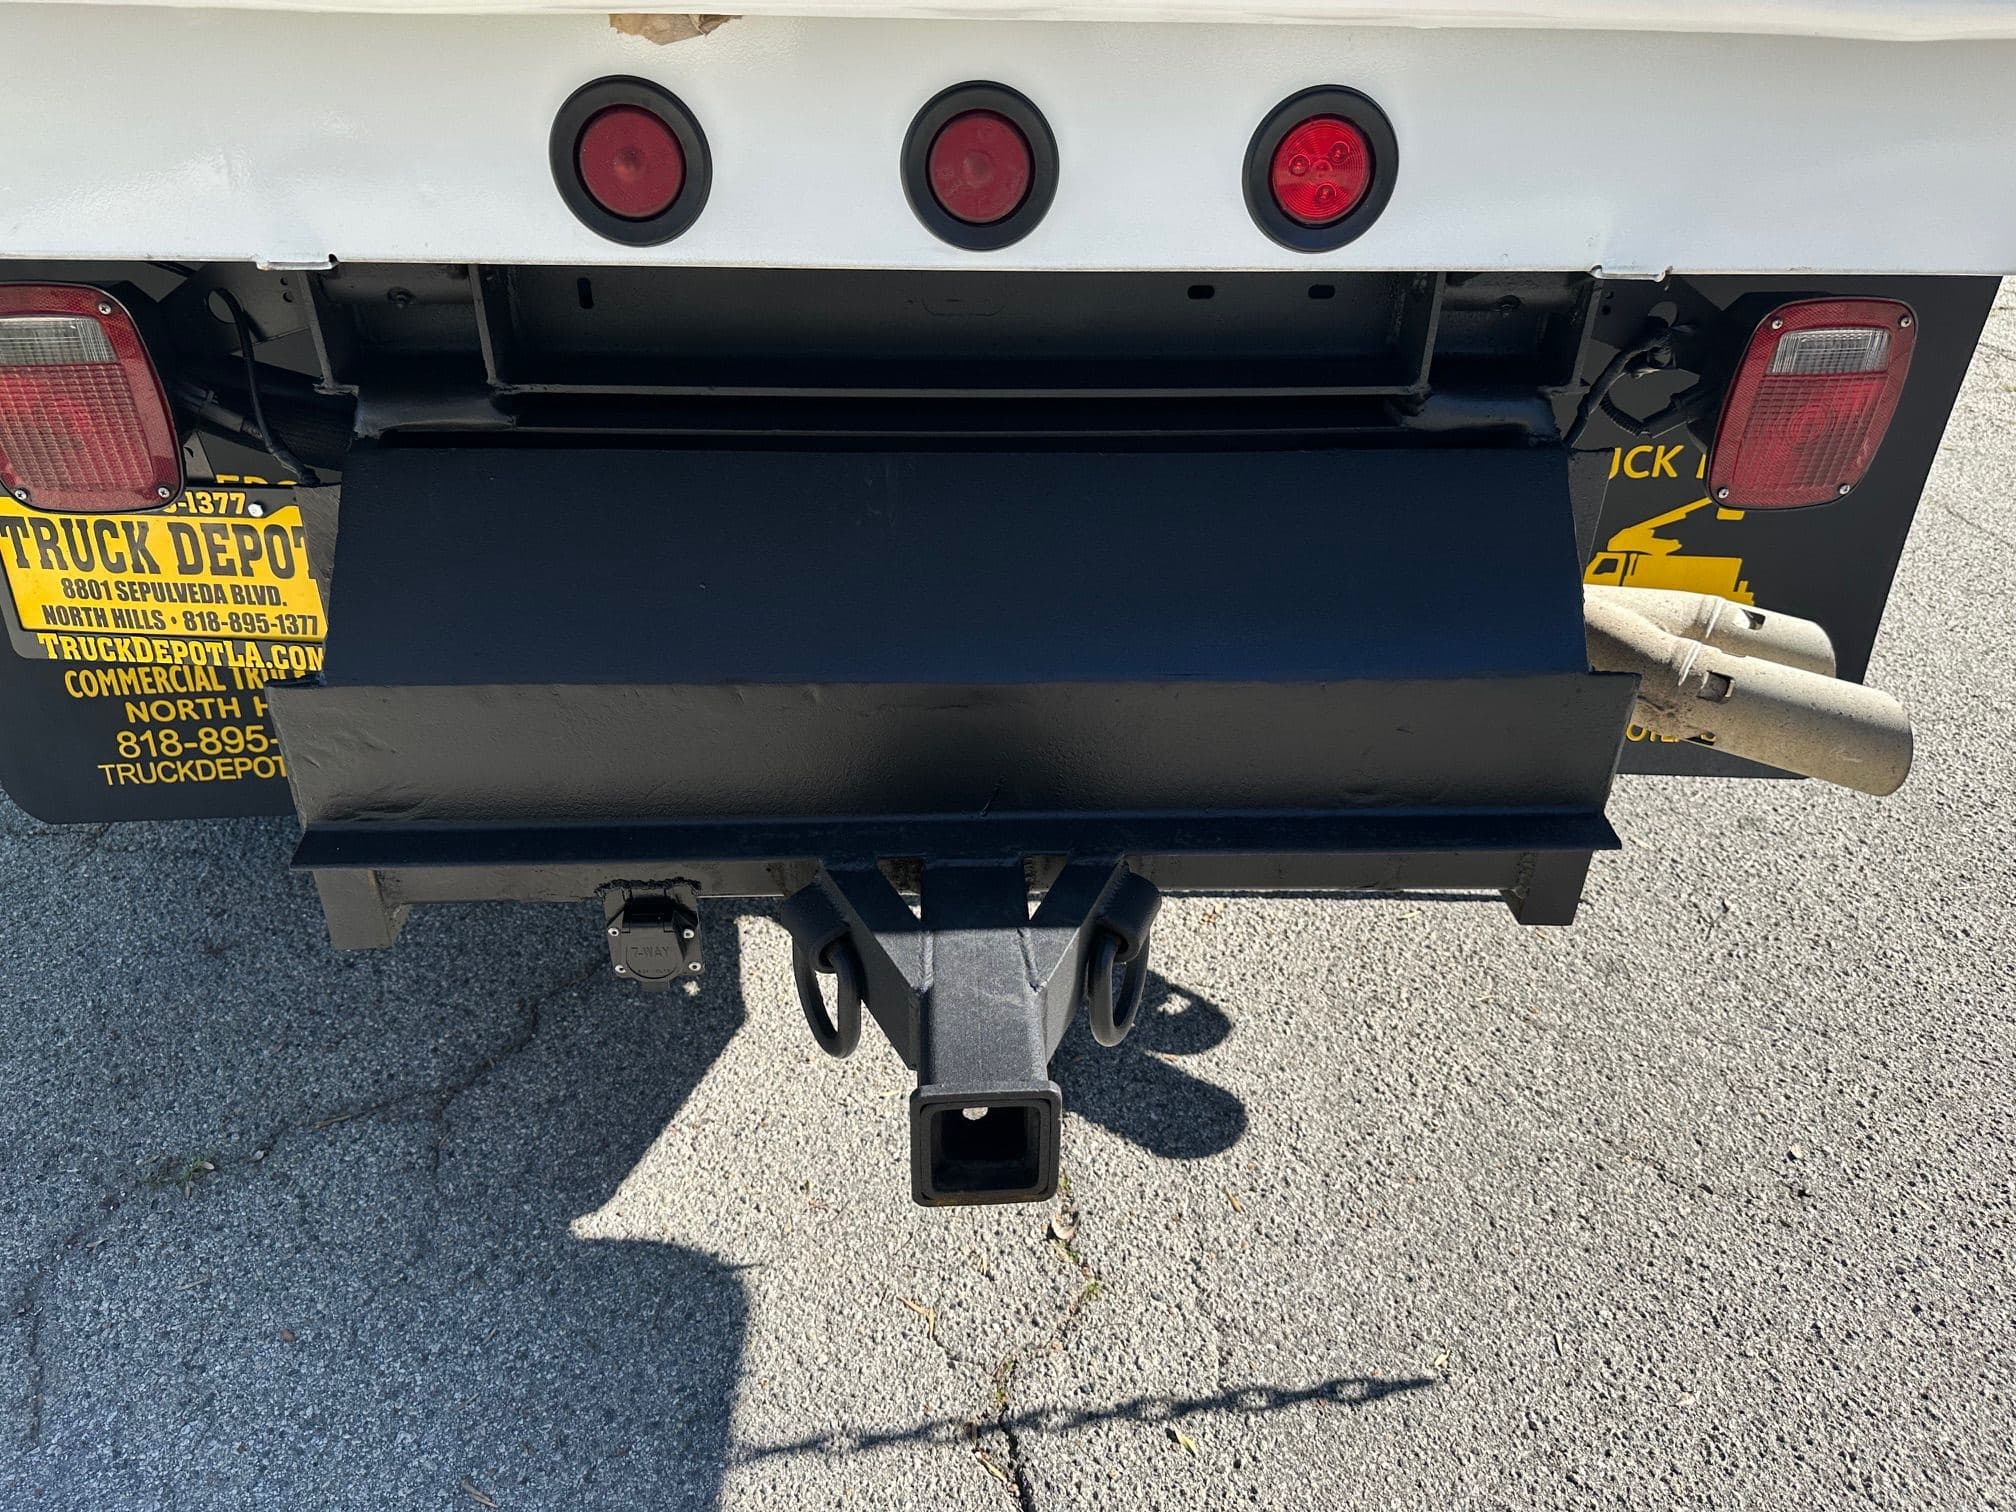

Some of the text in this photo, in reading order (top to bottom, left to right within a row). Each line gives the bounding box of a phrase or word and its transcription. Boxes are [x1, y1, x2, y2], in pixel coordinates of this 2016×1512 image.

[163, 491, 246, 514] -1377
[0, 516, 160, 575] TRUCK
[61, 577, 288, 606] 8801 SEPULVEDA BLVD.
[41, 604, 319, 635] NORTH HILLS 818-895-1377
[64, 665, 227, 698] COMMERCIAL
[124, 697, 242, 723] NORTH
